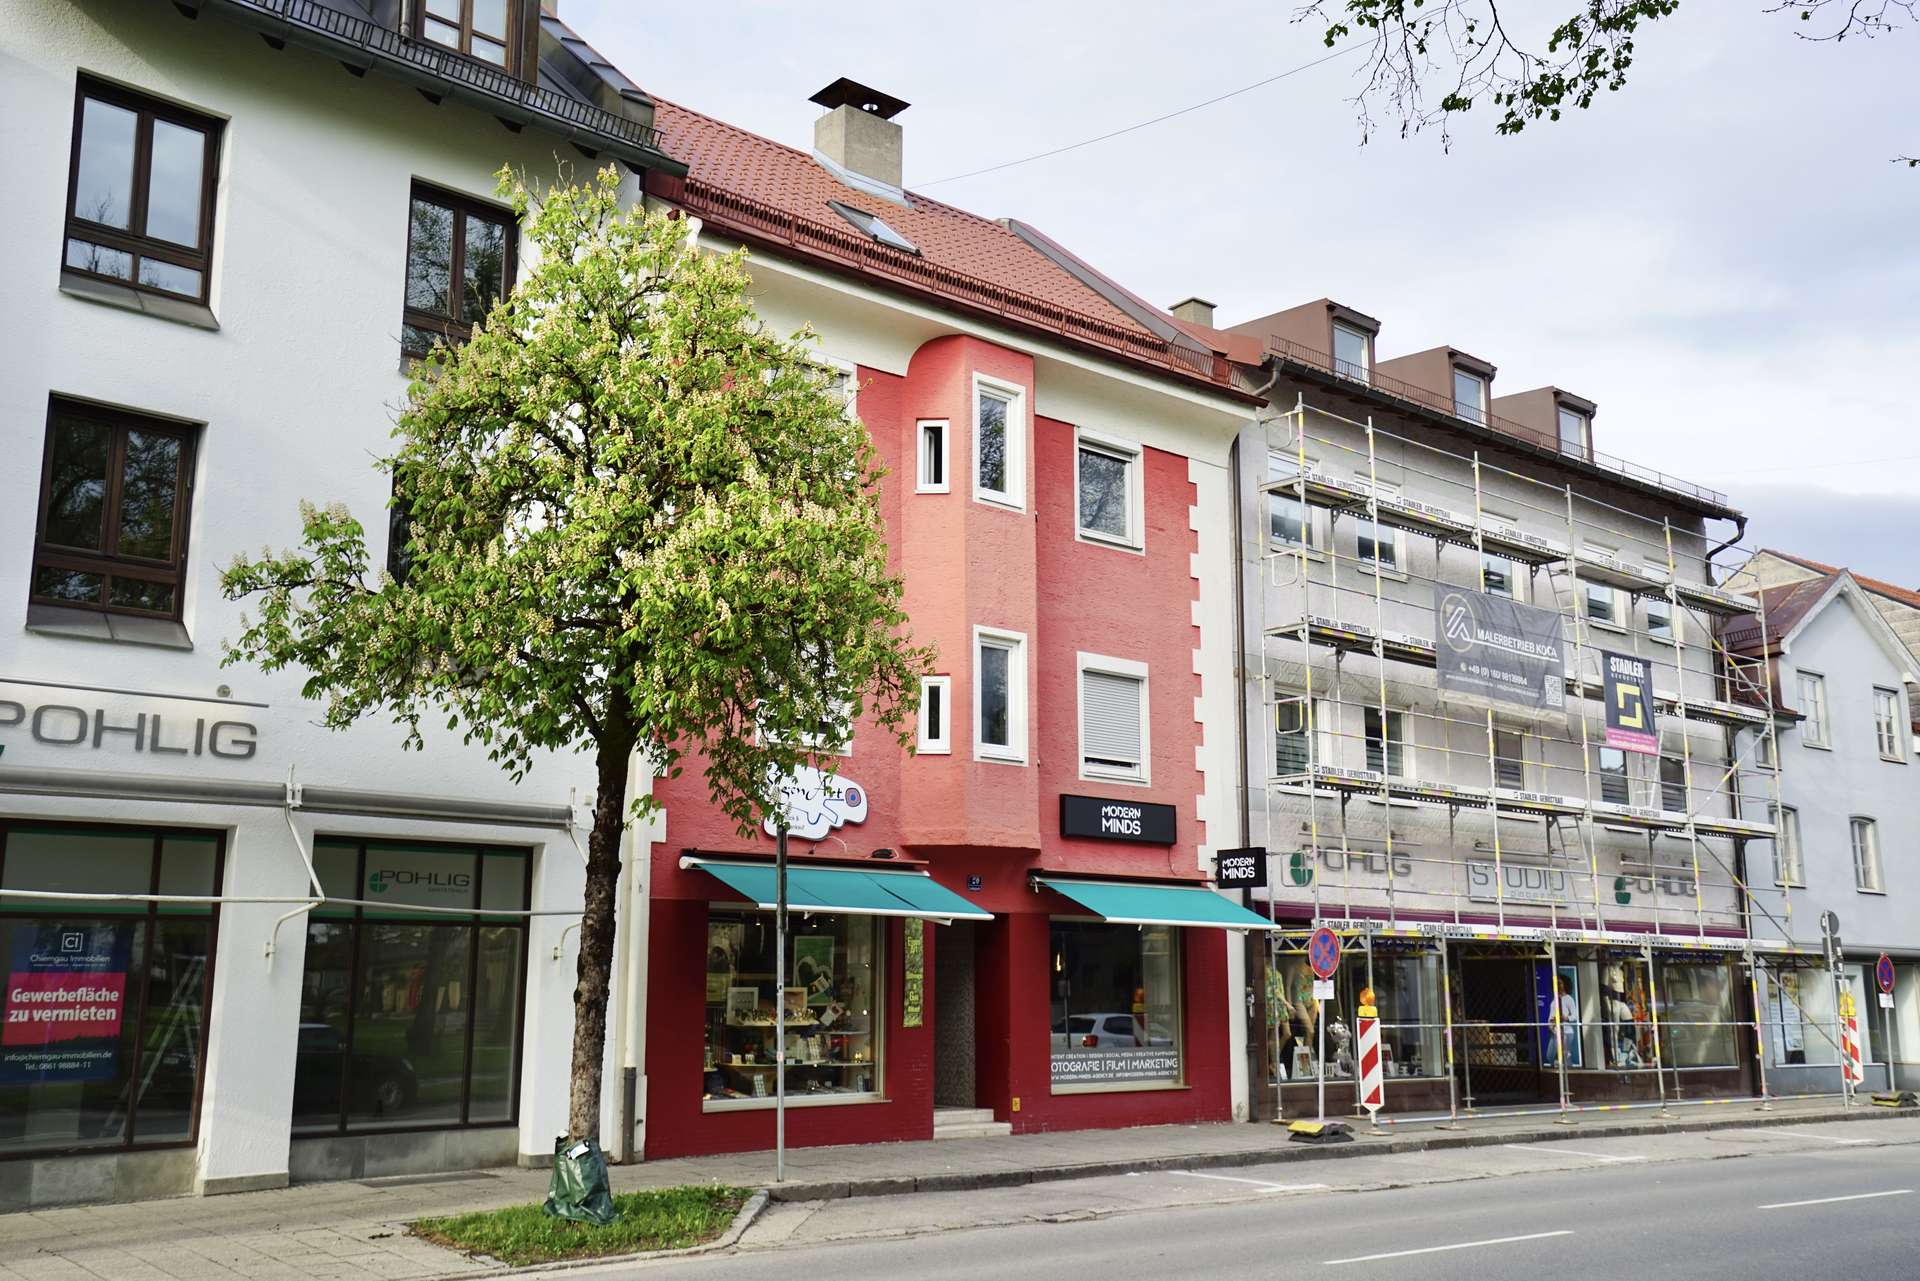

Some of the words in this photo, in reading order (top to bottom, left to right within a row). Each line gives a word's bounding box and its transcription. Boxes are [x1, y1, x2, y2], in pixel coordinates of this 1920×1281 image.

[1477, 629, 1535, 654] MALERBETRIEB
[1610, 656, 1644, 679] STADLER
[1321, 766, 1345, 777] STADLER
[1102, 805, 1141, 819] MODERN
[1102, 817, 1141, 835] MINDS
[1222, 856, 1255, 868] MODERN
[380, 869, 470, 887] POHLIG
[1222, 866, 1256, 879] MINDS
[1327, 919, 1350, 929] STADLER
[12, 987, 119, 1003] Gewerbefläche
[9, 1008, 29, 1023] zu
[32, 1005, 117, 1021] vermieten
[1051, 1060, 1100, 1072] OTOGRAFIE
[1106, 1059, 1126, 1071] FILM
[1131, 1058, 1178, 1070] MARKETING
